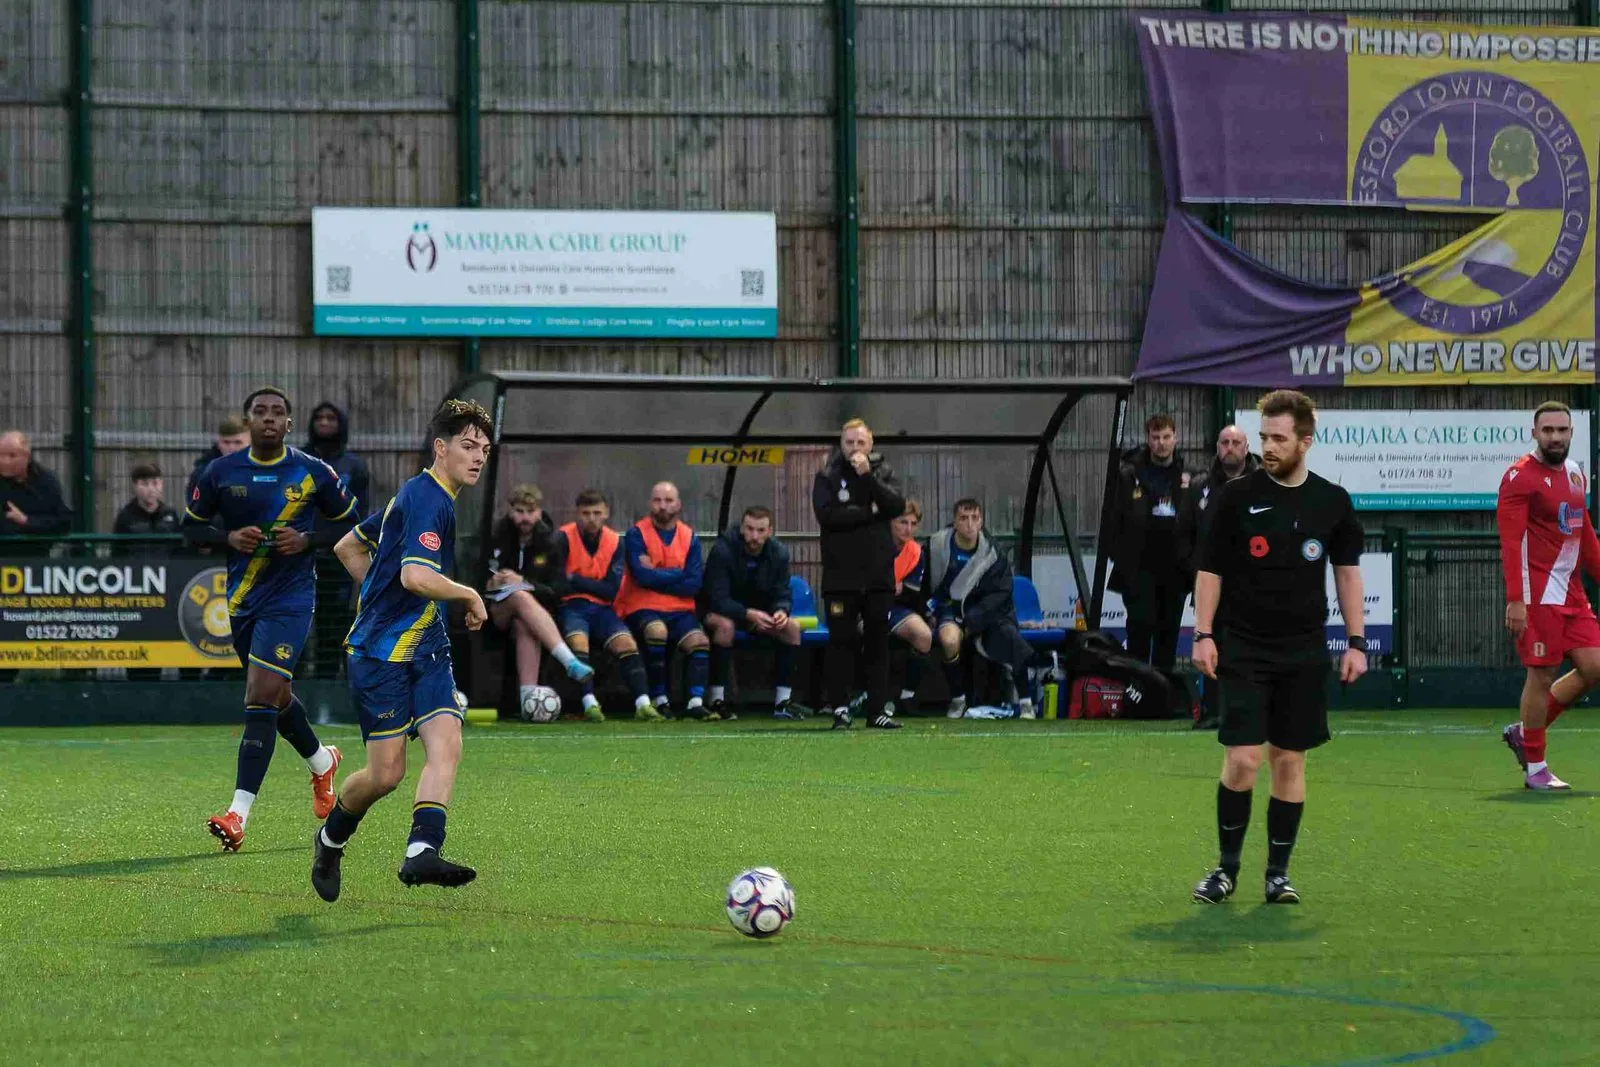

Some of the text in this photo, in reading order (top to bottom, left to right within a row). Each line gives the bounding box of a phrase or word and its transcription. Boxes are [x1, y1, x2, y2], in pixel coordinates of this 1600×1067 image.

[1140, 17, 1245, 49] THERE
[1252, 21, 1281, 49] IS
[1289, 20, 1443, 59] NOTHING
[1414, 76, 1493, 109] TOWN
[1503, 82, 1585, 202] FOOTBALL
[1547, 209, 1584, 279] CLUB
[444, 231, 687, 254] MARJARA CARE GROUP
[1470, 301, 1519, 329] 1974
[1290, 341, 1595, 376] WHO NEVER GIVE
[1313, 426, 1532, 446] MARJARA CARE GROU
[701, 448, 768, 464] HOME
[1424, 453, 1441, 462] Care
[1443, 453, 1469, 462] Homes
[30, 596, 72, 607] DOORS
[74, 597, 101, 607] AND
[104, 596, 165, 607] SHUTTERS
[26, 625, 67, 639] 01522
